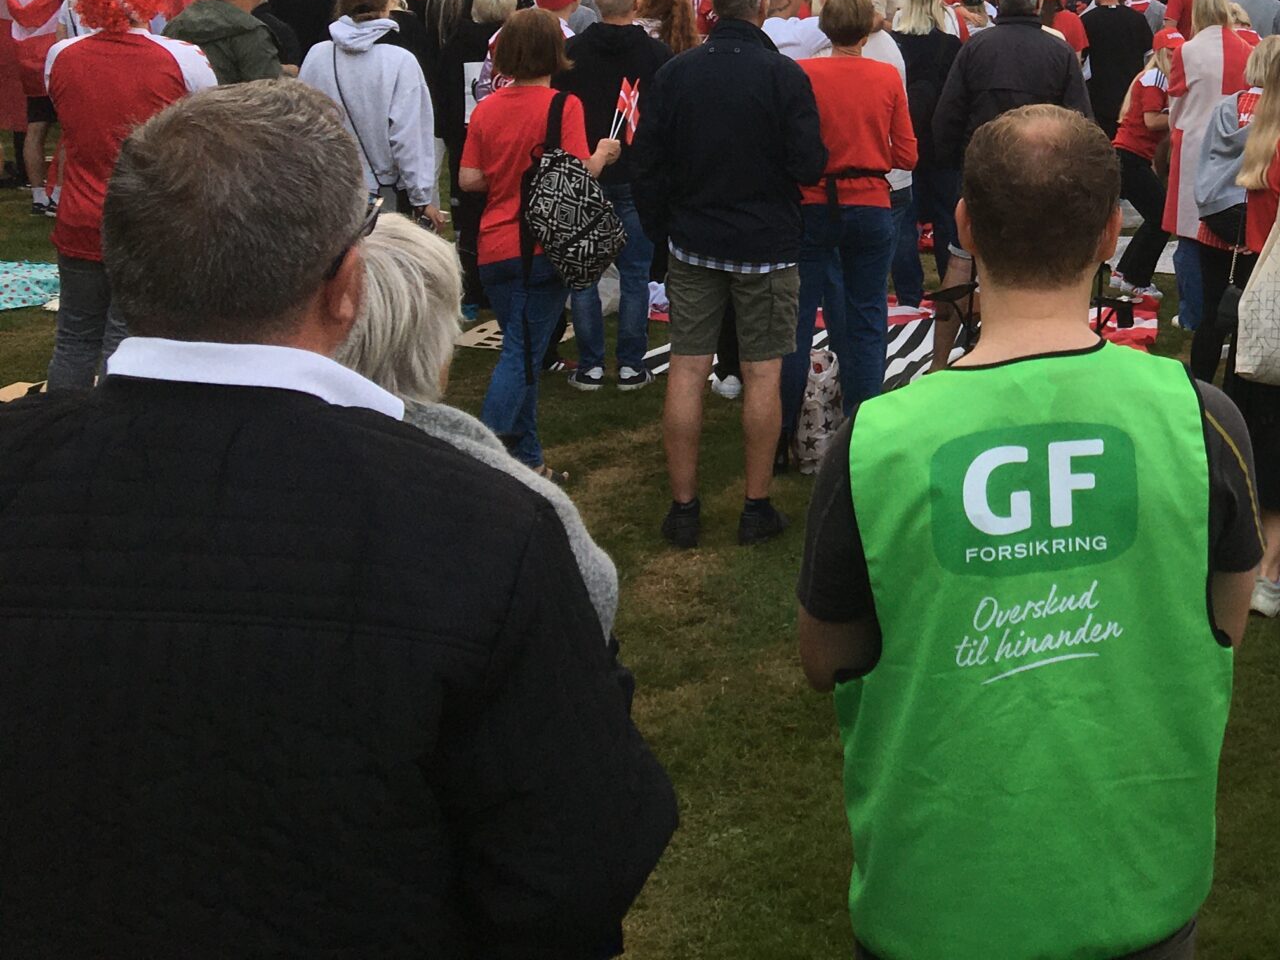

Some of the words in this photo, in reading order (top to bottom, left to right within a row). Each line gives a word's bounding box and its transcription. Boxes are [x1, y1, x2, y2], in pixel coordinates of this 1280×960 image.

[962, 438, 1105, 536] GF
[965, 535, 1108, 563] FORSIKRING
[972, 580, 1100, 632] Overskud
[954, 635, 988, 667] til
[996, 612, 1124, 664] hinanden
